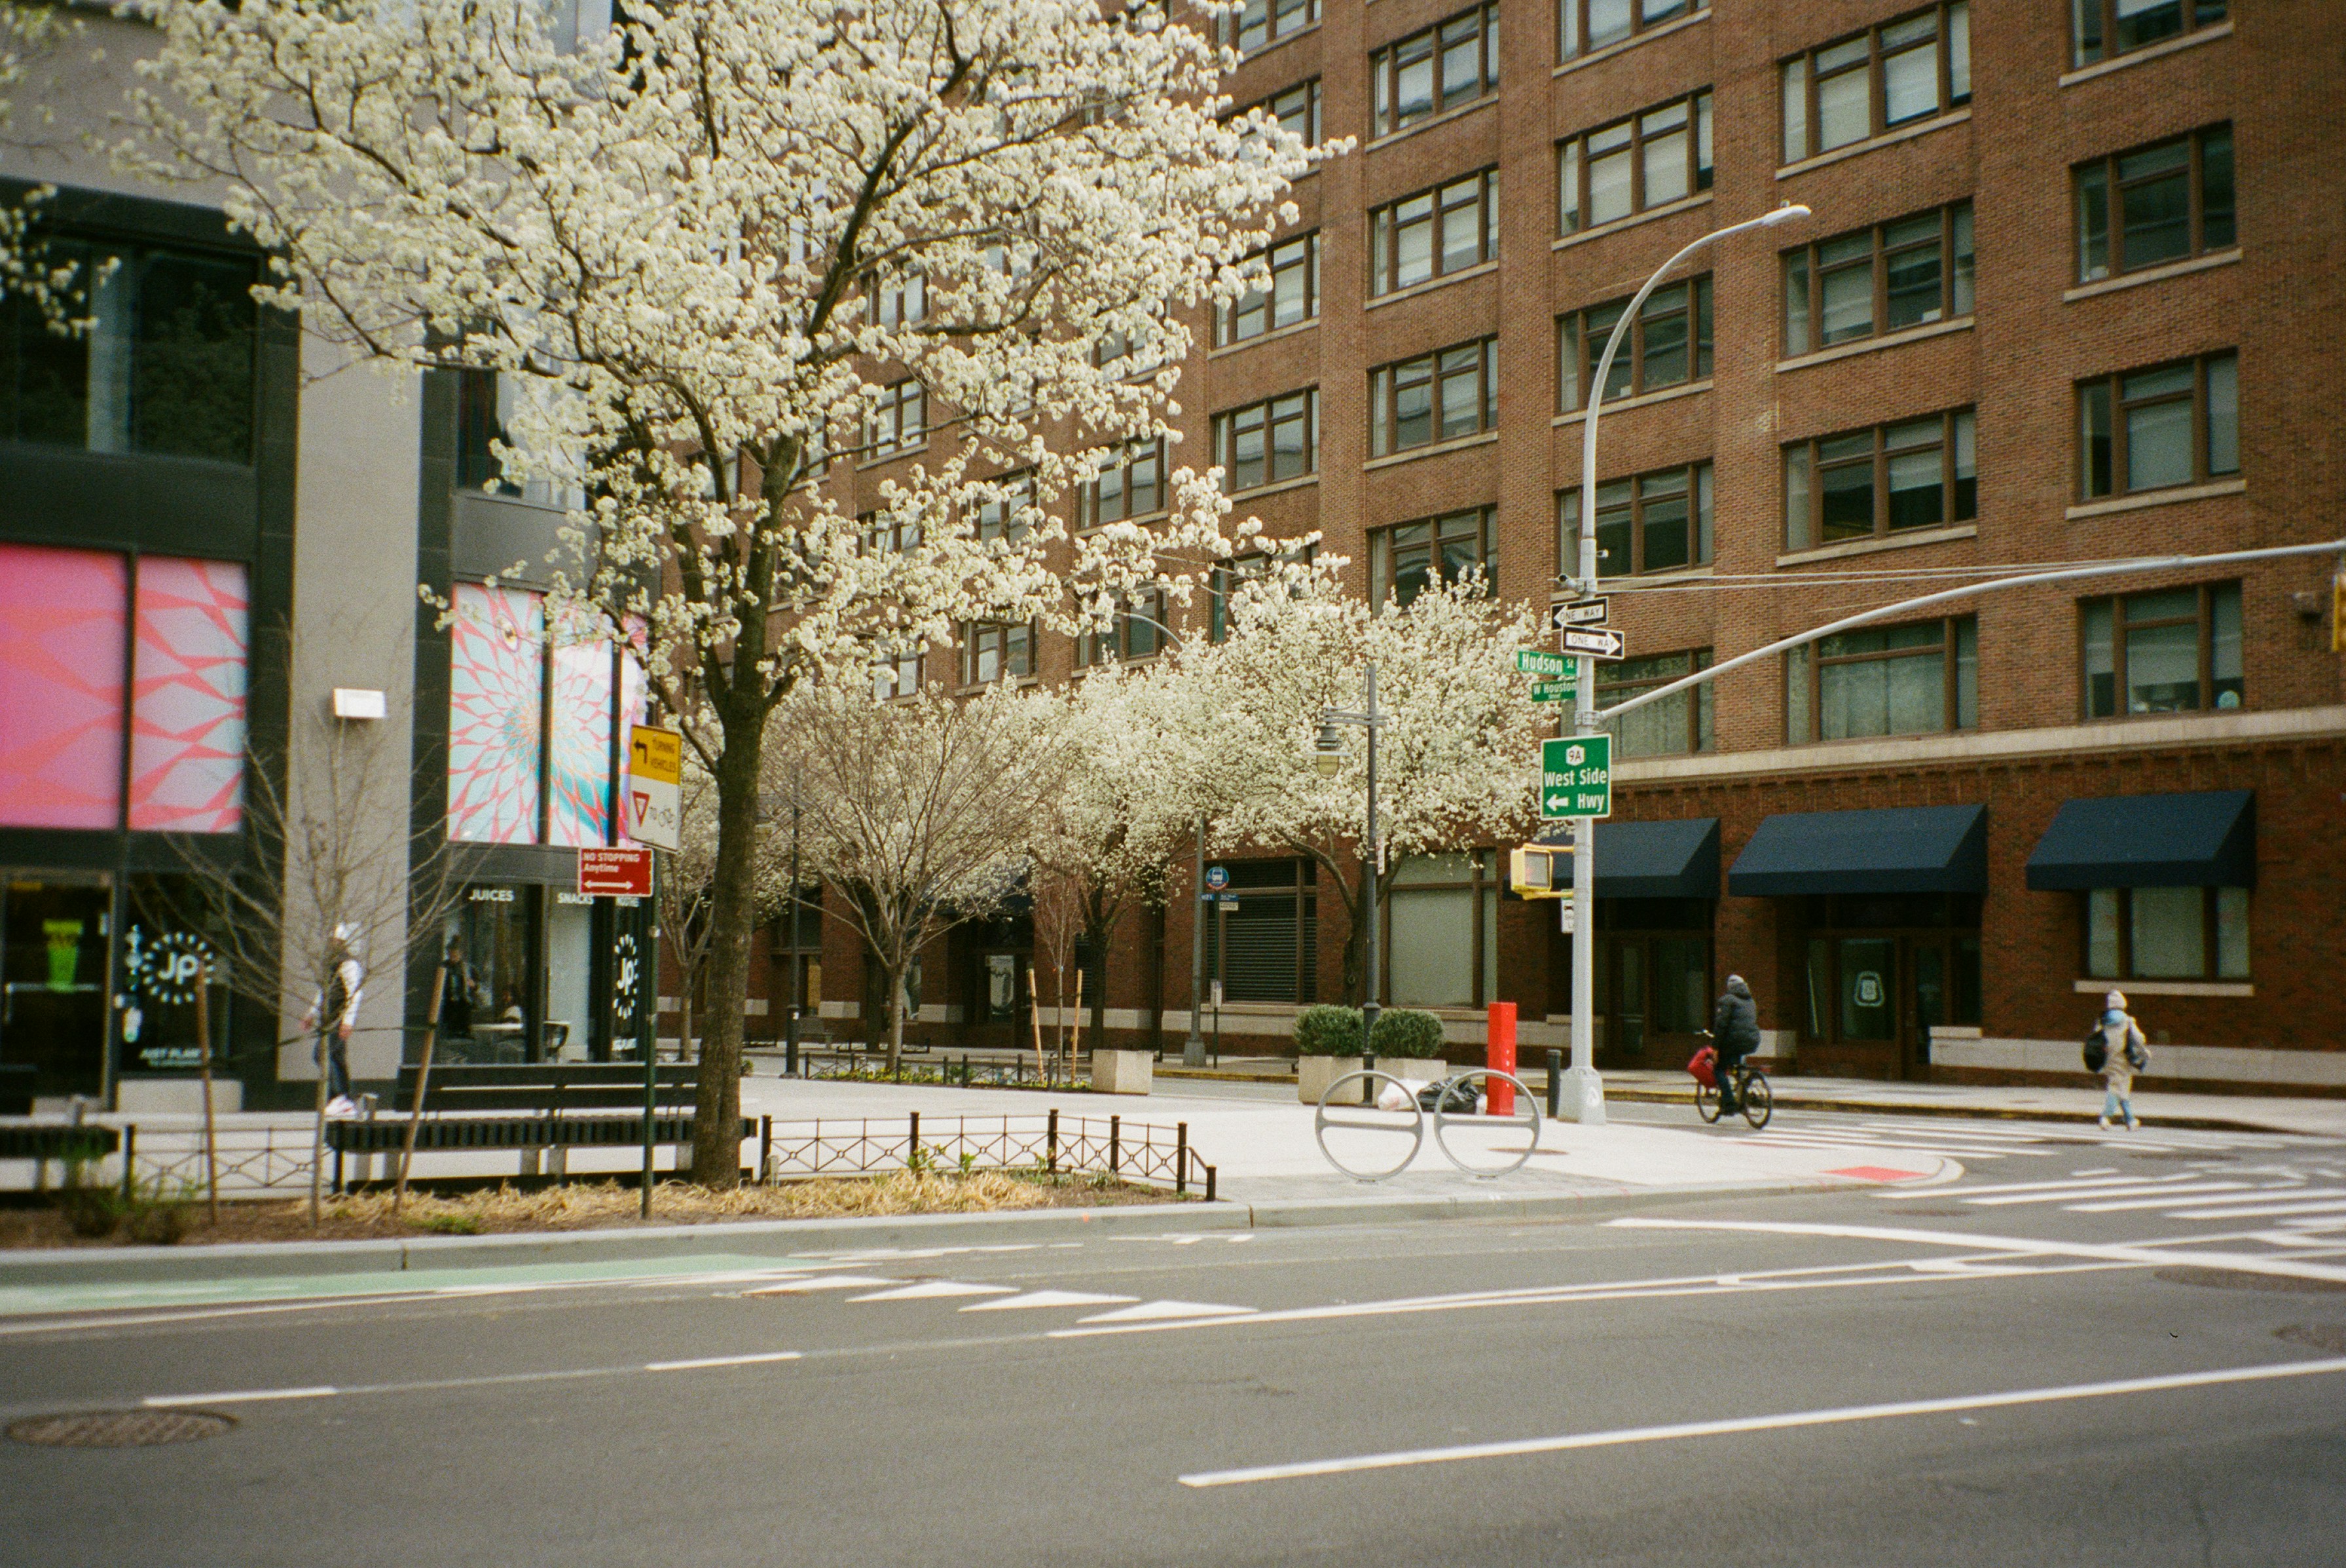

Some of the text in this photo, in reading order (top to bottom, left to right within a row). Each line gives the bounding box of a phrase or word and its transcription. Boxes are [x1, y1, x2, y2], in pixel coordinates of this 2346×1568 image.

[1560, 606, 1601, 622] ONE WAY
[1571, 634, 1615, 647] ONE WAY
[1522, 653, 1574, 673] Hudson St
[1533, 682, 1576, 695] W Houston
[1569, 750, 1582, 761] 9A
[1544, 767, 1607, 788] West Side
[1577, 793, 1605, 812] Hwy
[583, 852, 640, 863] NO STOPPING
[584, 864, 619, 874] Anytime
[469, 889, 515, 902] JUICES
[557, 892, 594, 904] SNACKS
